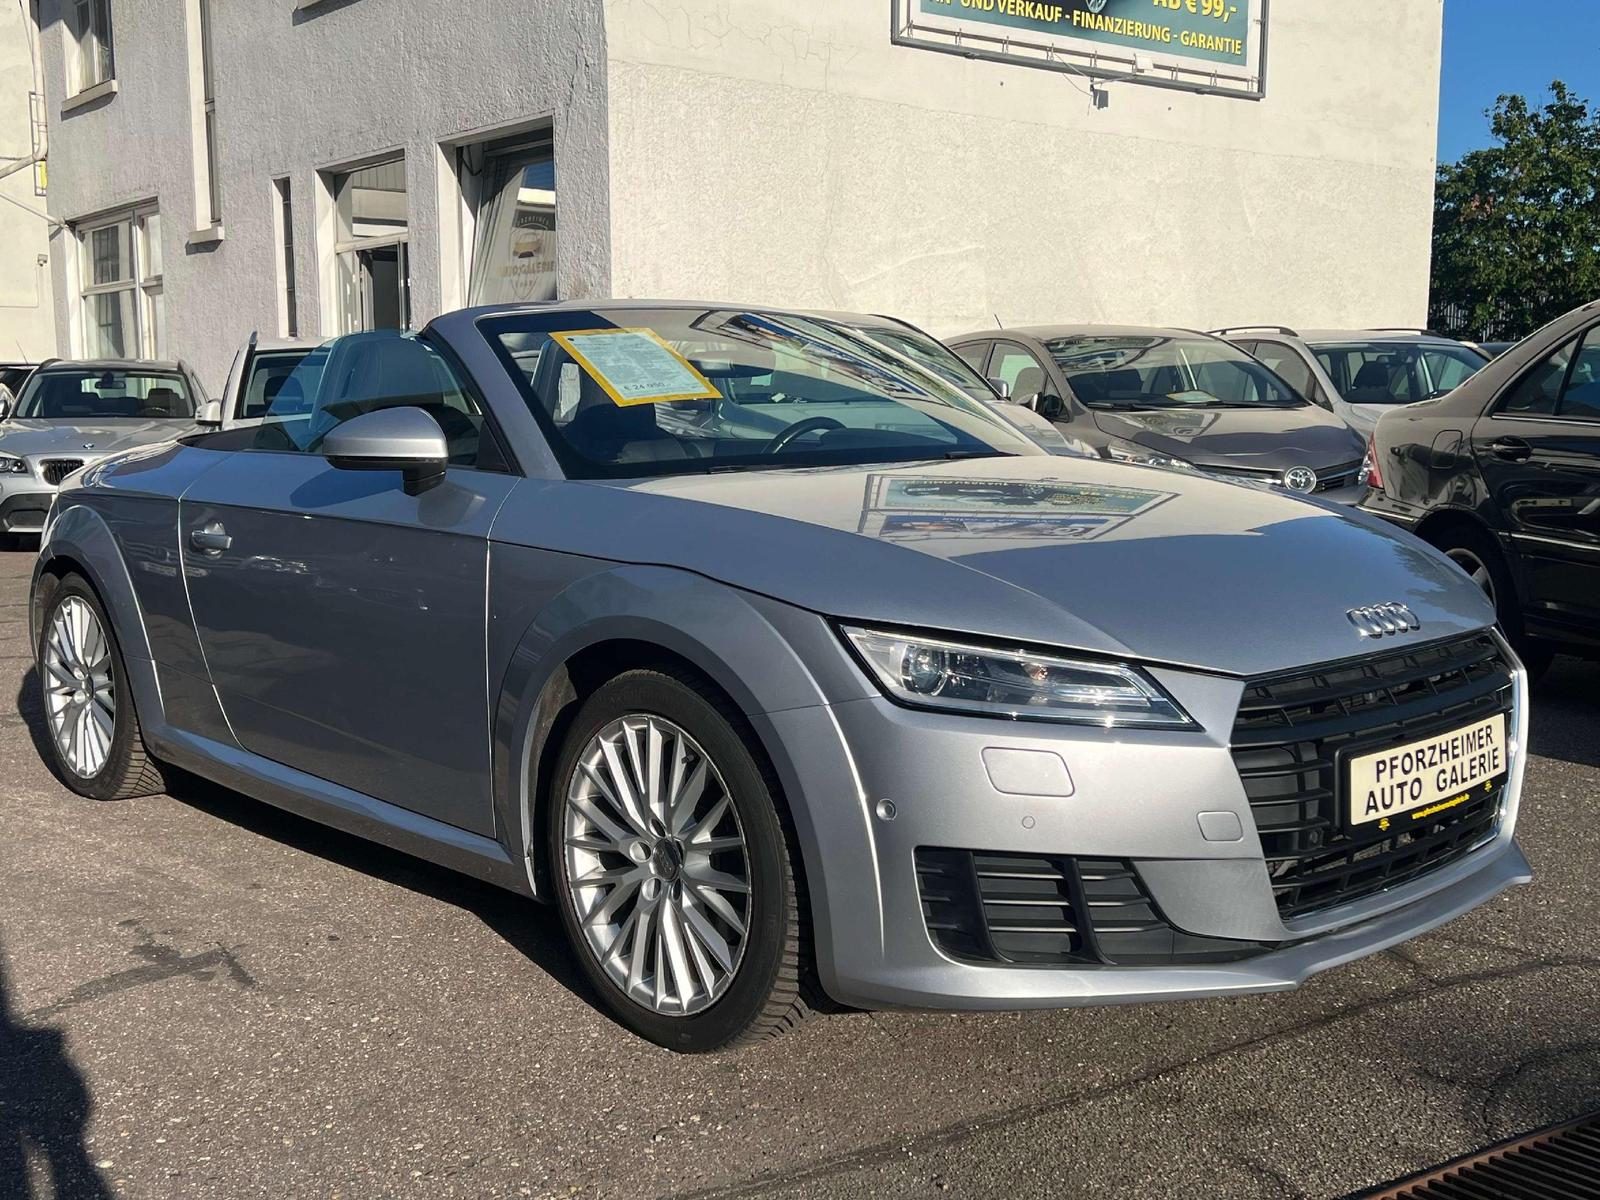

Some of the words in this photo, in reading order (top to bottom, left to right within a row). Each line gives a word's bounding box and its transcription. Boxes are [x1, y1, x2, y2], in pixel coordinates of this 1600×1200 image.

[997, 0, 1063, 23] VERKAUF
[1072, 10, 1171, 43] FINANZIERUNG
[1180, 30, 1243, 56] GARANTIE
[1365, 777, 1423, 816] AUTO
[1436, 747, 1500, 793] GALERIE
[1376, 724, 1494, 784] PFORZHEIMER
